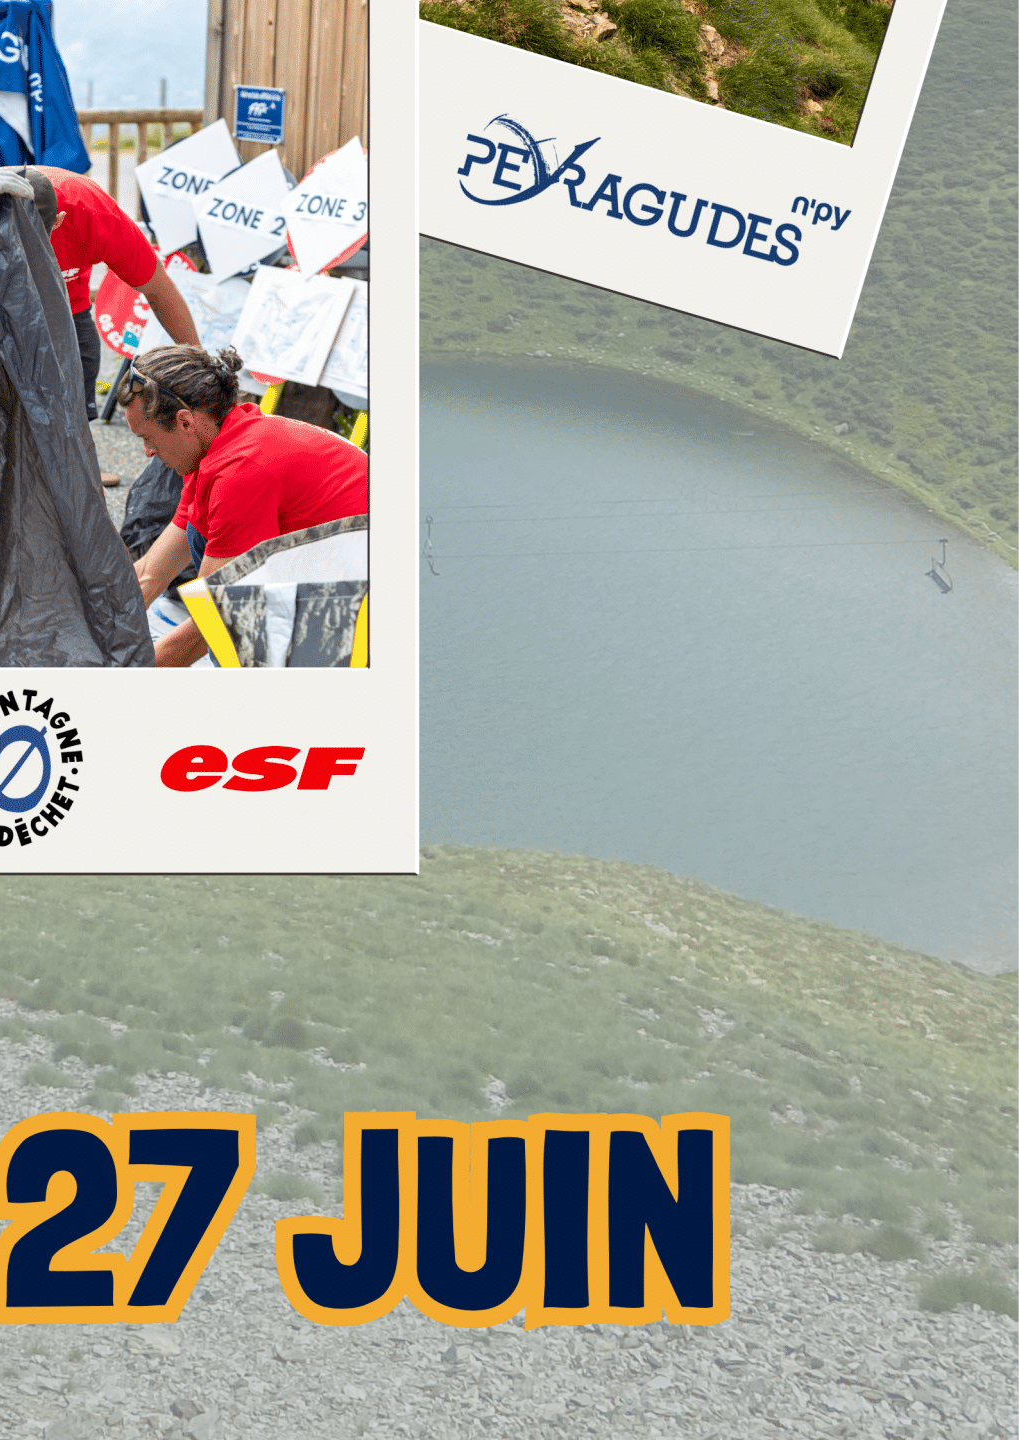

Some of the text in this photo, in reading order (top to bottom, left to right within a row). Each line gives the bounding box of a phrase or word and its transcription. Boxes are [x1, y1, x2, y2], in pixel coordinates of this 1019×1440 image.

[207, 197, 286, 236] ZONE 2
[295, 193, 367, 221] ZONE 3
